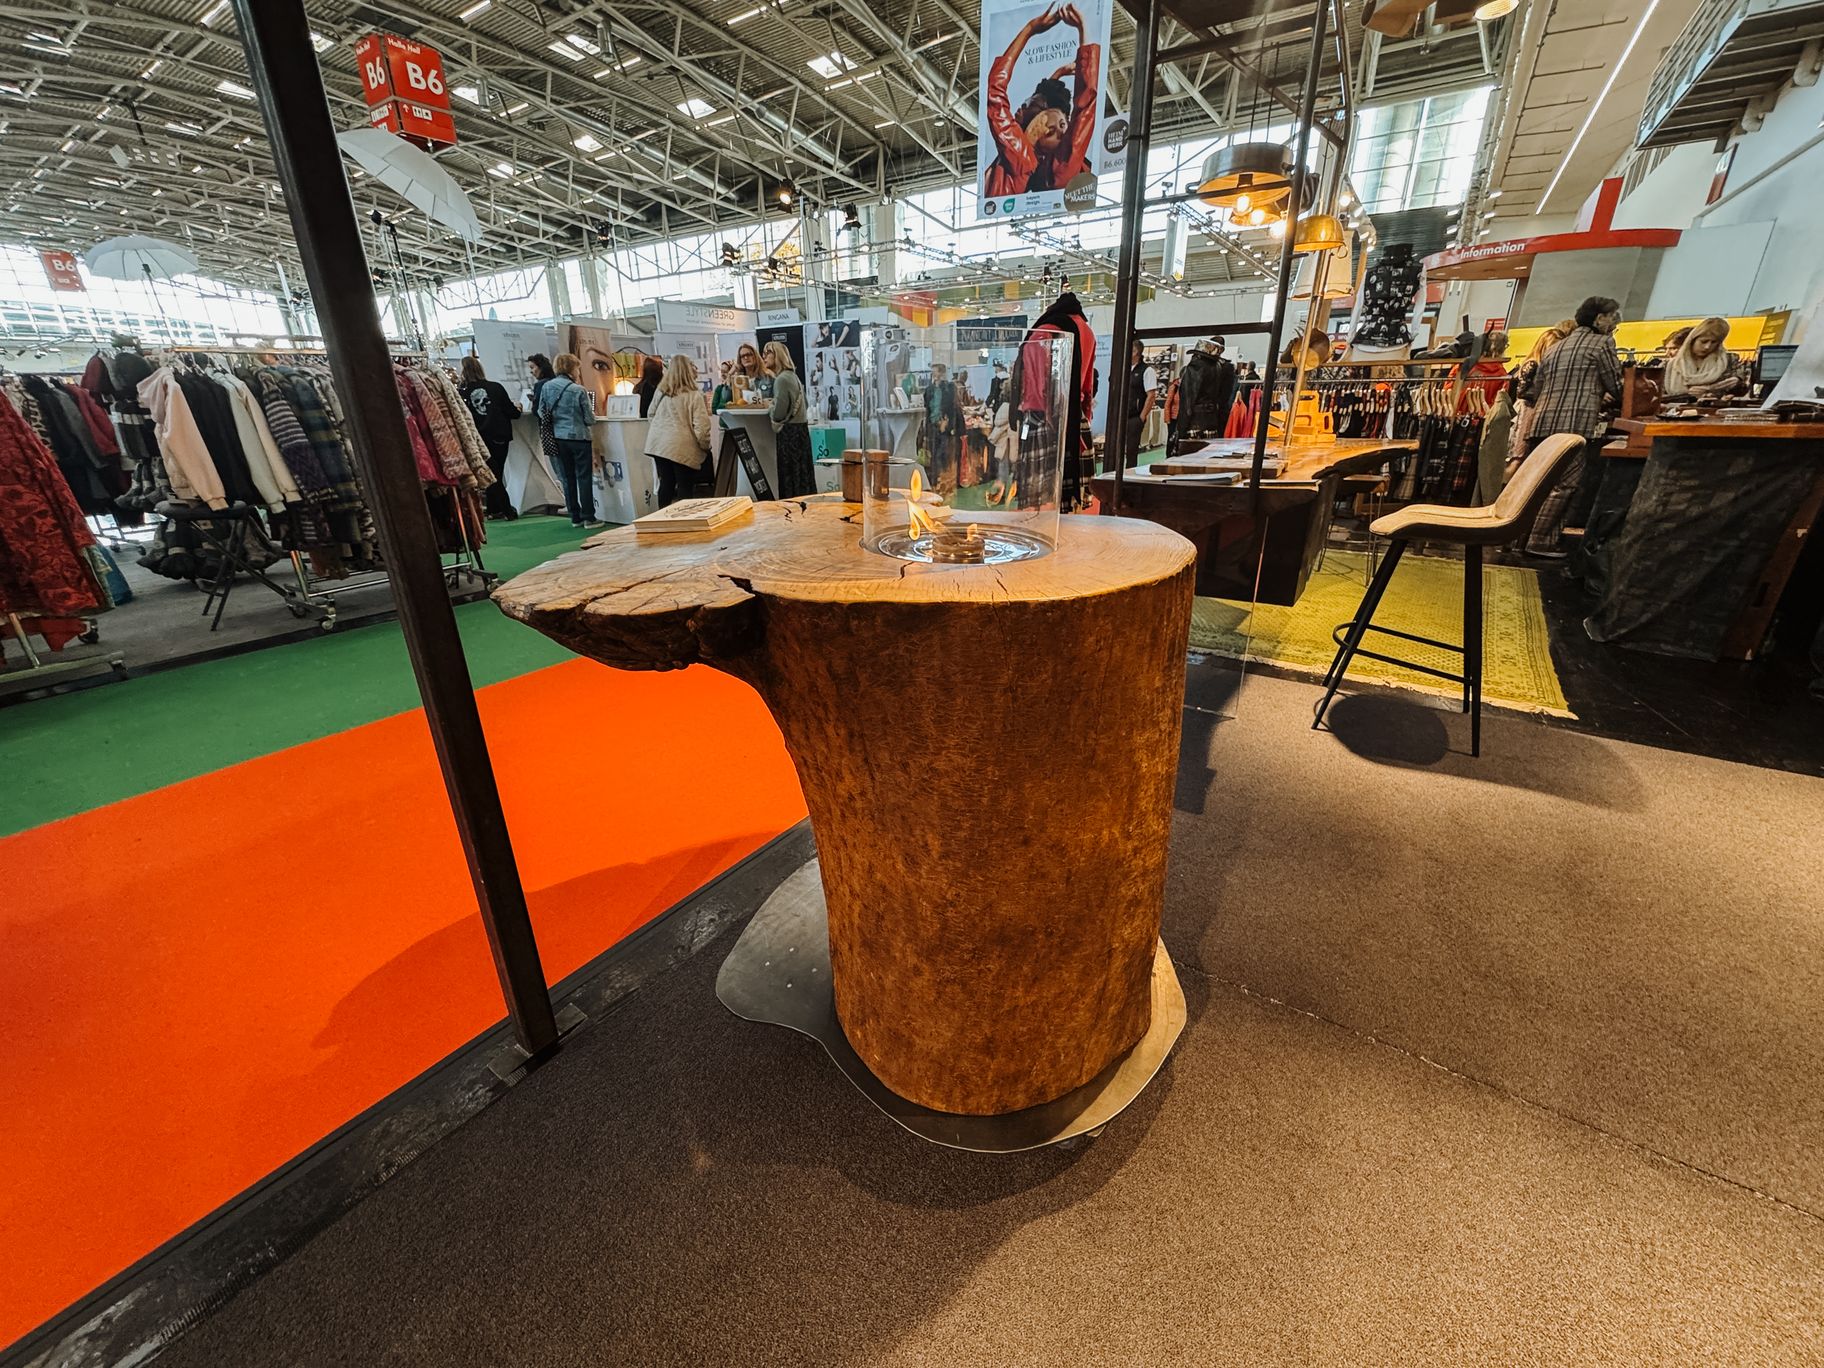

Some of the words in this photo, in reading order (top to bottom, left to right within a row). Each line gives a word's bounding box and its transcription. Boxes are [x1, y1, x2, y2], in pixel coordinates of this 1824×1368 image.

[387, 38, 406, 50] Halle
[407, 44, 421, 54] Hall
[1024, 45, 1044, 56] SLOW
[1046, 39, 1078, 53] FASHION
[1027, 57, 1034, 65] &
[1035, 50, 1072, 64] LIFESTYLE
[365, 56, 385, 90] B6
[405, 61, 444, 95] B6
[1065, 188, 1081, 200] MEET
[1070, 194, 1096, 202] MAKERS
[1460, 242, 1526, 259] Information
[52, 259, 76, 271] B6
